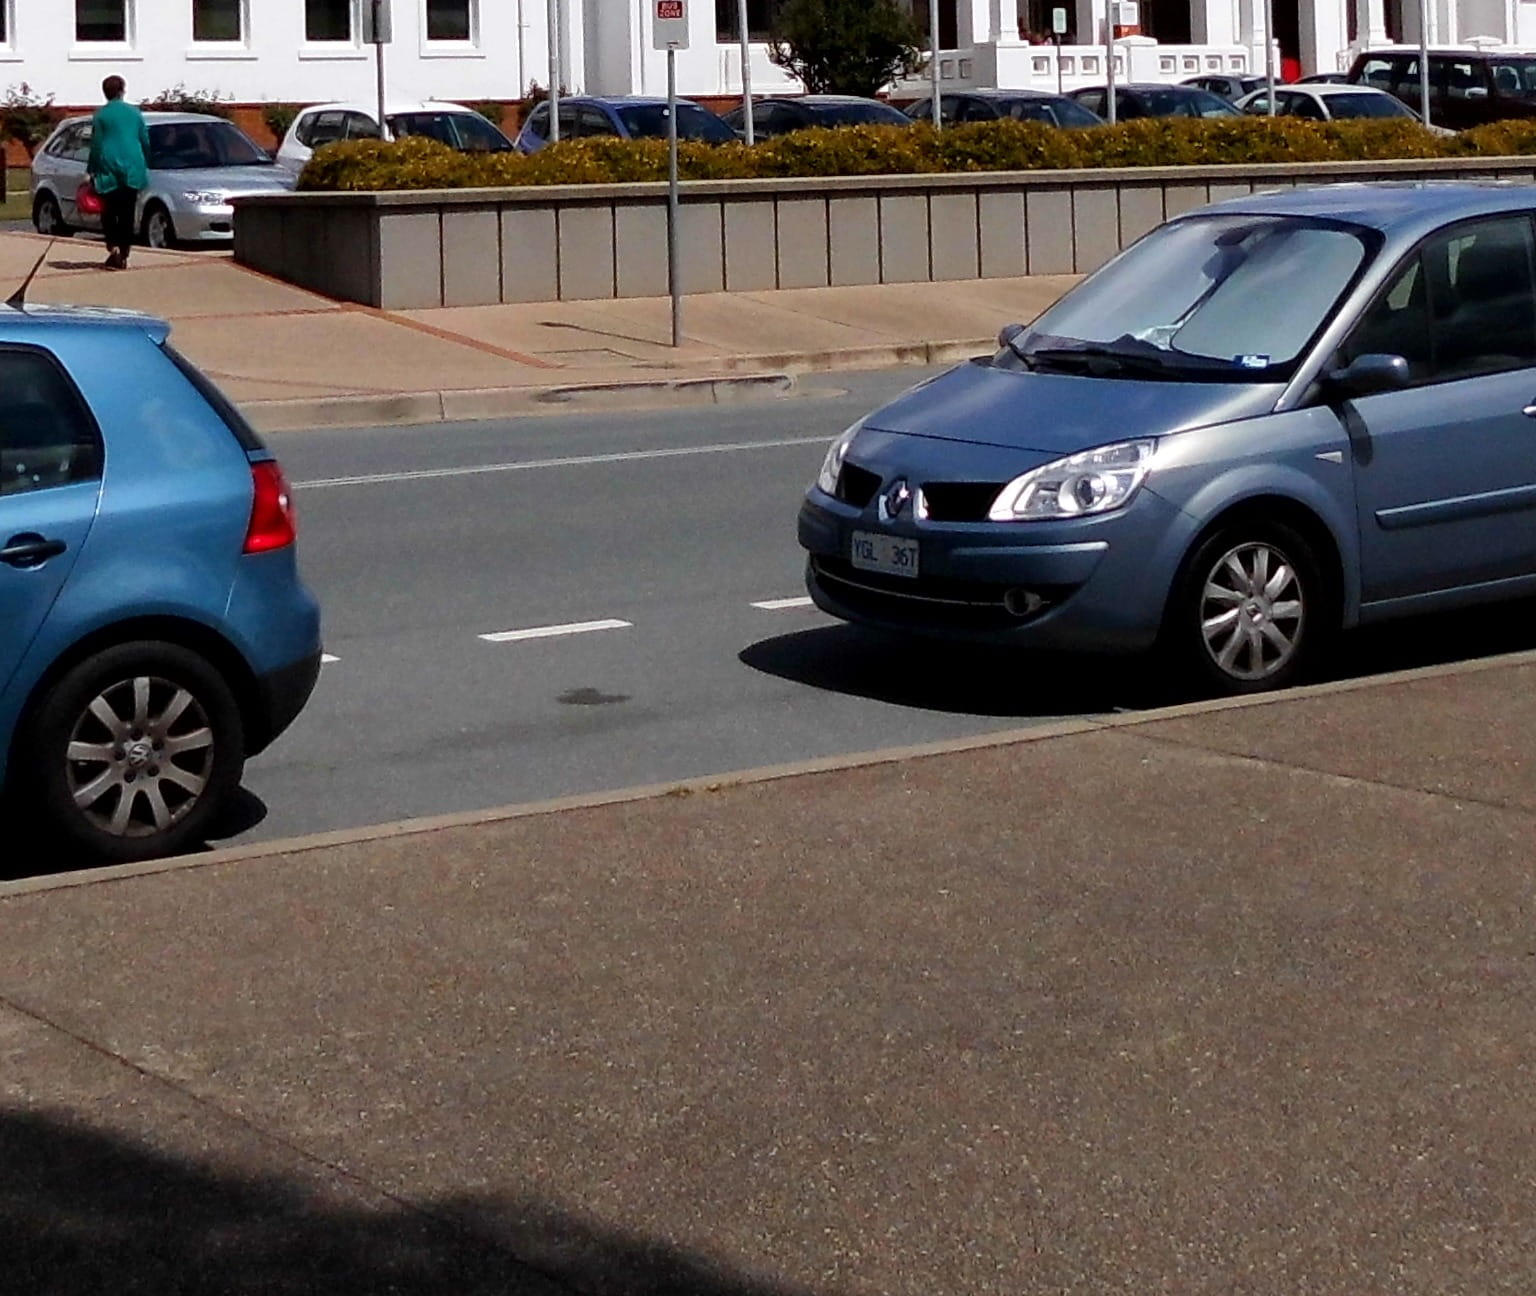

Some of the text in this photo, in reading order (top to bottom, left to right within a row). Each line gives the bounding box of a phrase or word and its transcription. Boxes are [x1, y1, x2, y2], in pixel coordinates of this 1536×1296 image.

[661, 2, 678, 10] BUS
[659, 9, 681, 17] ZONE
[854, 538, 917, 568] YGL 36T
